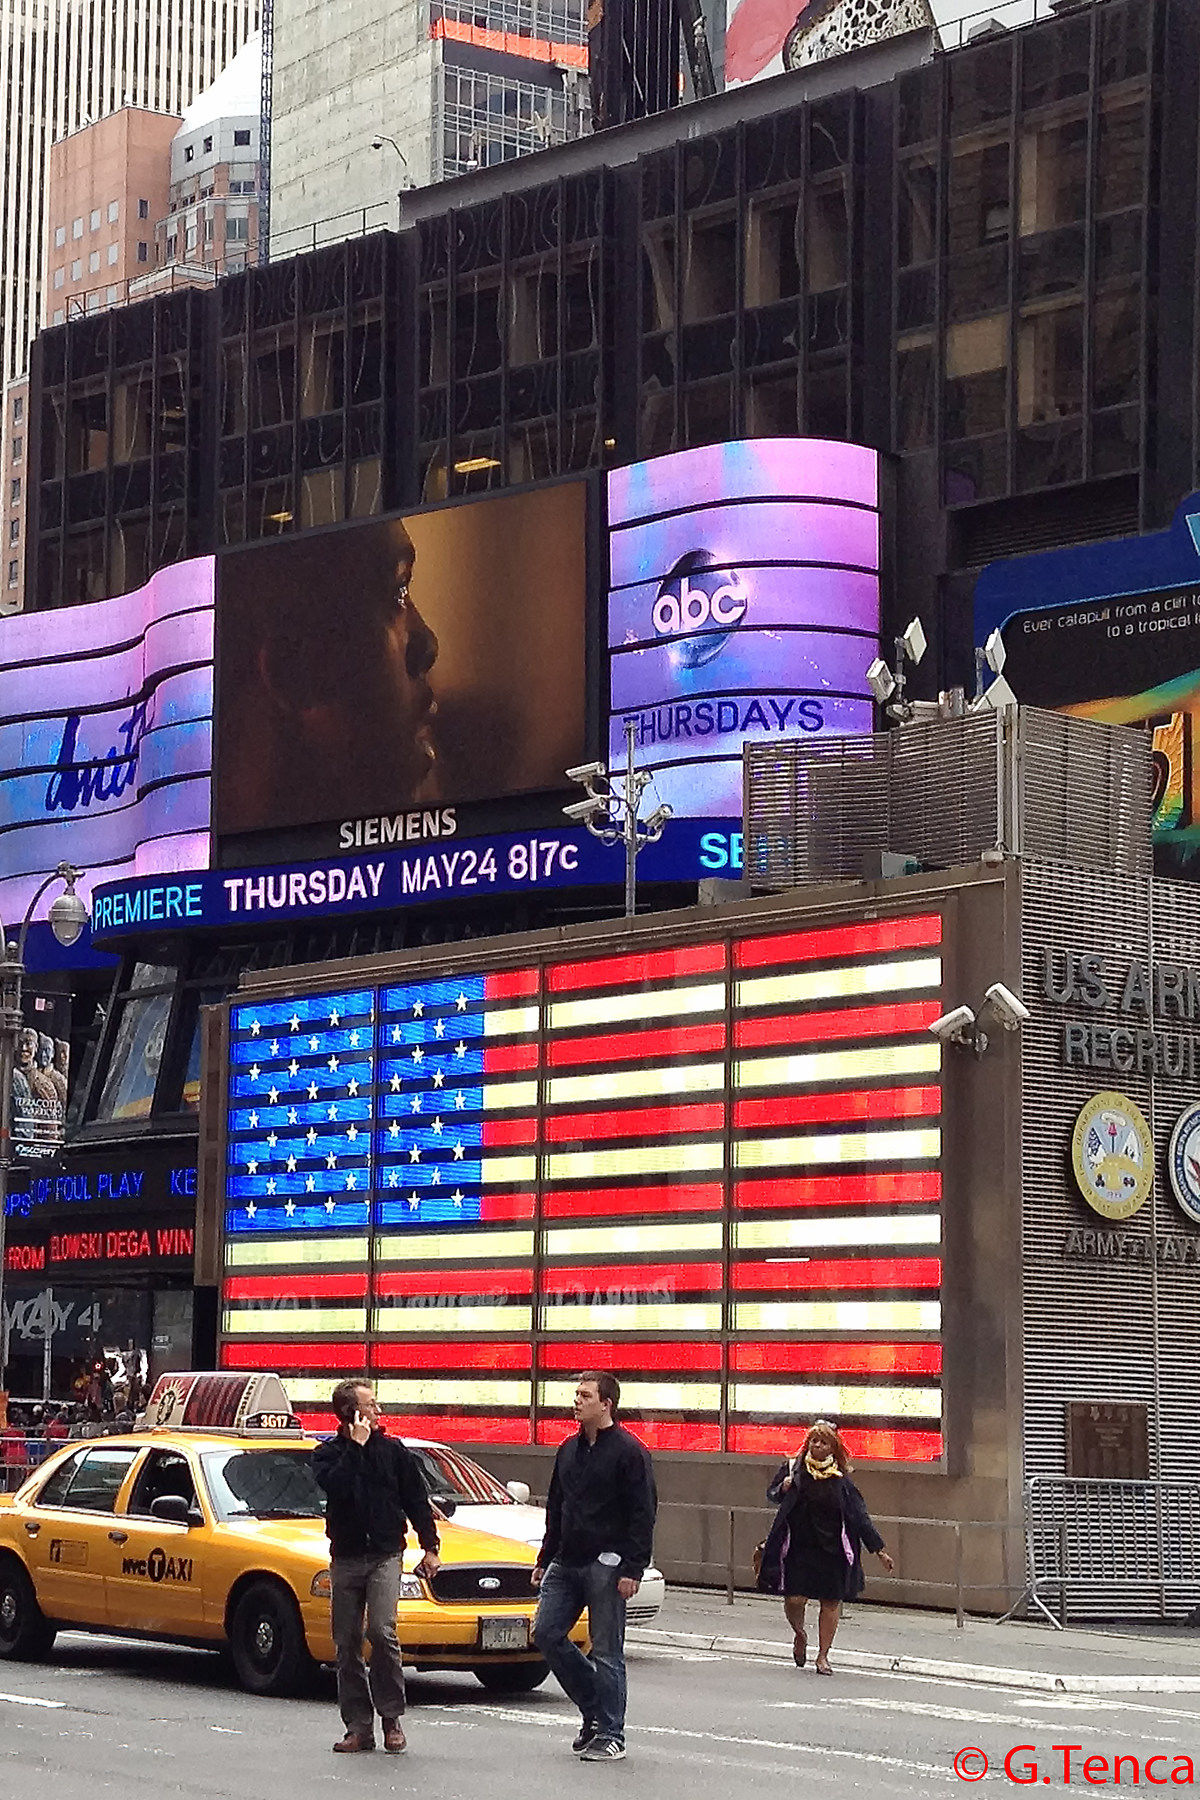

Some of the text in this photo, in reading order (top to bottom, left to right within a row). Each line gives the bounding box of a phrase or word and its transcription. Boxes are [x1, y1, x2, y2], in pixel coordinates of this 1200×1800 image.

[653, 577, 746, 634] abc
[1107, 625, 1120, 637] to
[1125, 623, 1134, 635] a
[1138, 614, 1191, 632] tropical
[1115, 602, 1147, 617] from
[1151, 601, 1160, 613] a
[623, 699, 824, 745] THURSDAYS
[339, 808, 457, 849] SIEMENS
[93, 884, 203, 929] PREMIERE
[224, 862, 385, 912] THURSDAY
[55, 1175, 92, 1201] FOUL
[98, 1171, 144, 1197] PLAY
[5, 1246, 45, 1271] FROM
[105, 1230, 151, 1260] DEGA
[156, 1228, 194, 1256] WIN
[260, 1414, 288, 1428] 3G17
